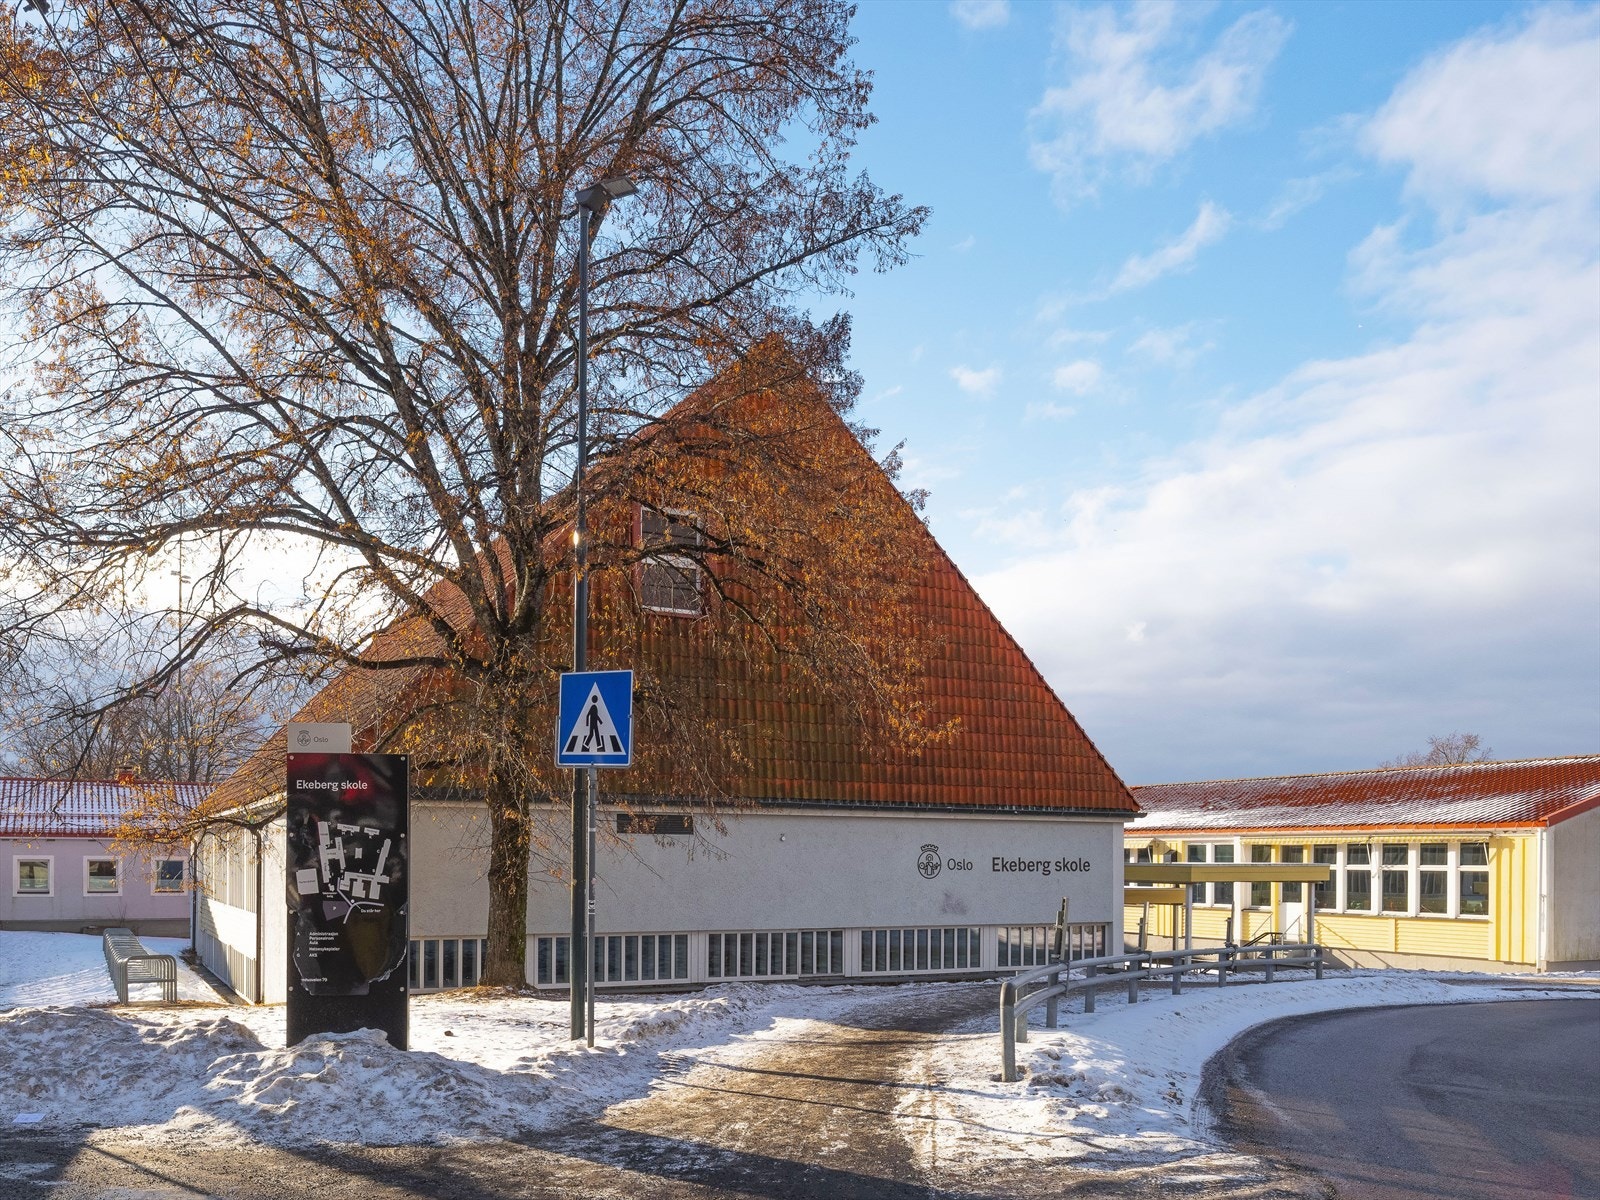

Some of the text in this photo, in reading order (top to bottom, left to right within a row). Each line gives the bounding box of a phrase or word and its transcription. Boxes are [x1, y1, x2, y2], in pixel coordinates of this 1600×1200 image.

[296, 780, 368, 791] Ekeberg skole
[947, 858, 973, 871] Oslo
[992, 857, 1091, 876] Ekeberg skole
